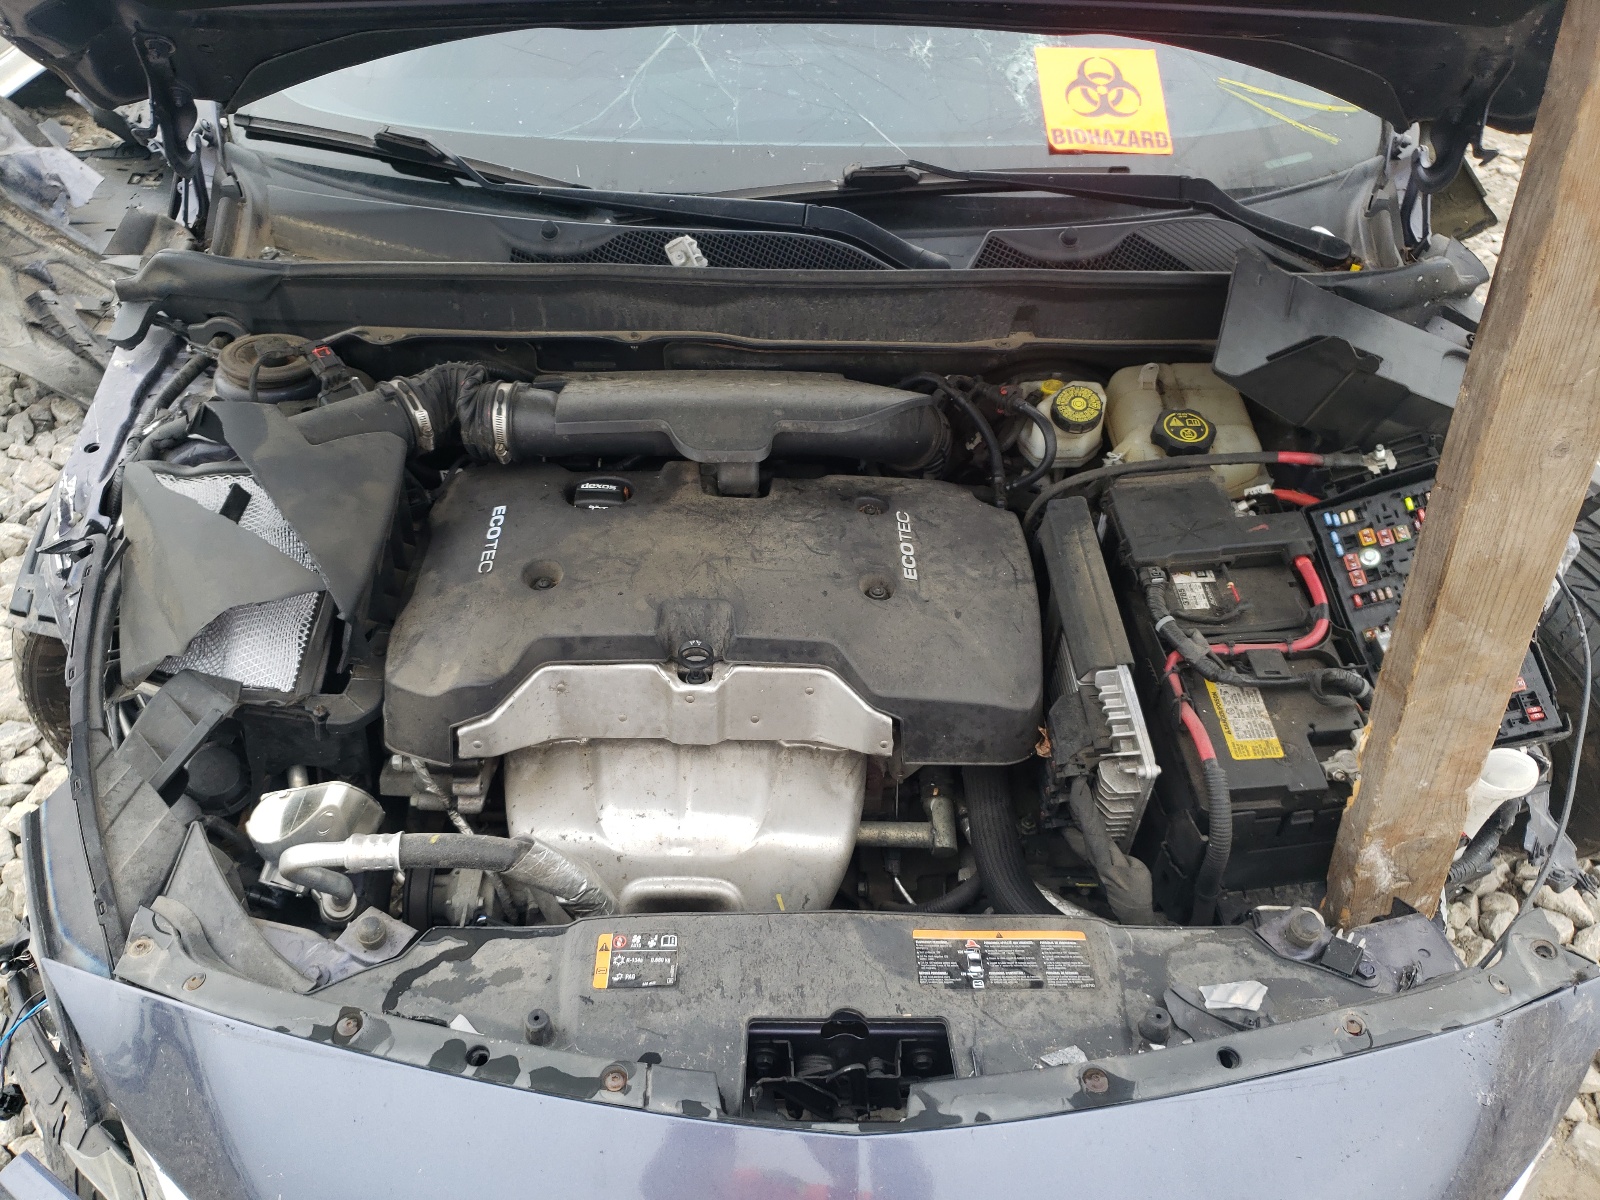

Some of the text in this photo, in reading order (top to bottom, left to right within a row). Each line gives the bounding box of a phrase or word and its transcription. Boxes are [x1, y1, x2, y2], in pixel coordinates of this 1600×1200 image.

[1051, 128, 1169, 148] BIOHAZARD
[580, 482, 618, 491] dexos
[478, 505, 507, 574] ECOTEC
[896, 511, 918, 580] ECOTEC
